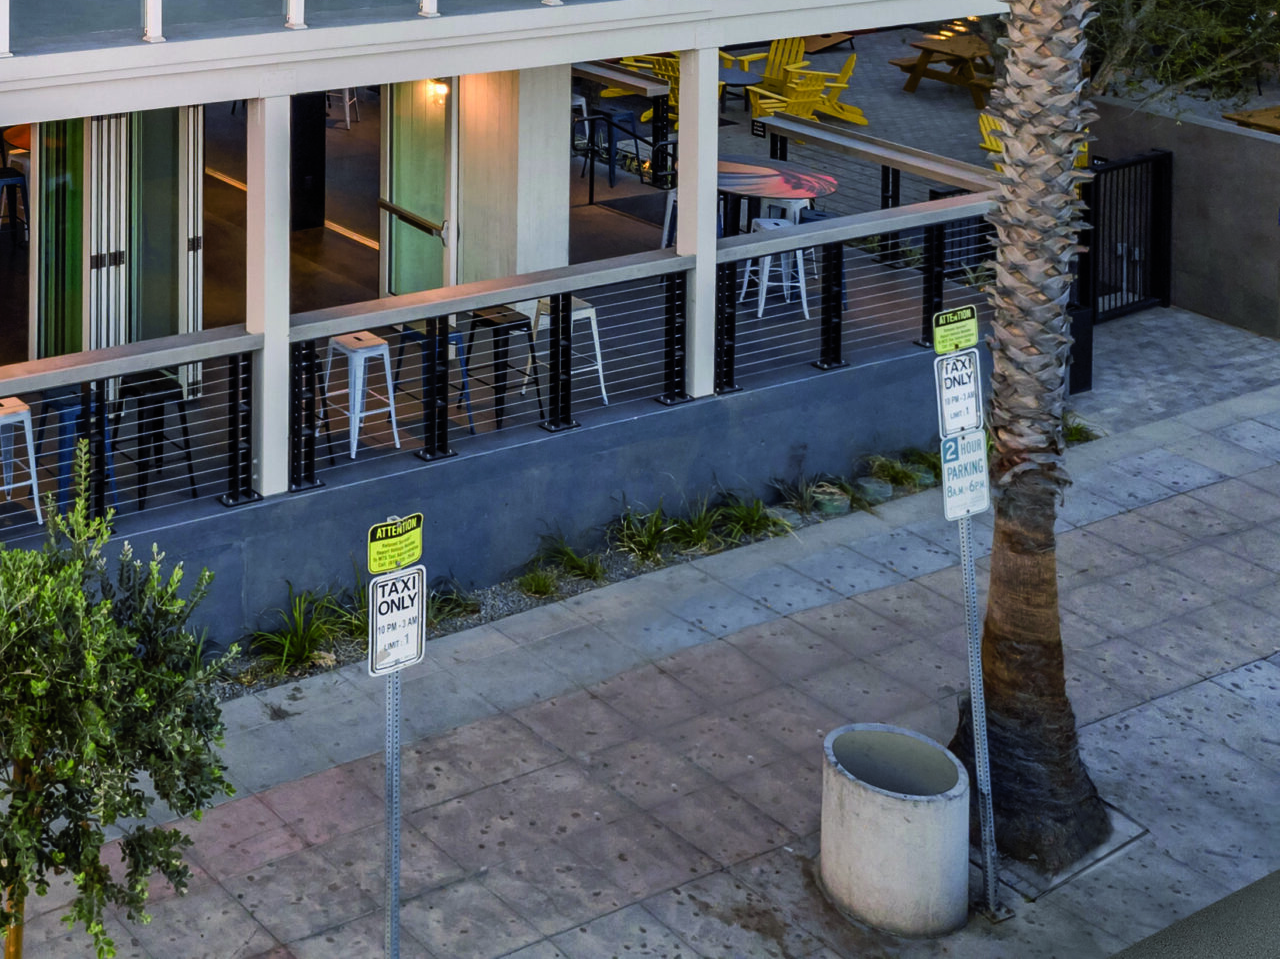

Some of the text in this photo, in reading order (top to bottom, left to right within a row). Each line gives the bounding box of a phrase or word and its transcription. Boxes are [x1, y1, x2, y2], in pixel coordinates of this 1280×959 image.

[939, 309, 971, 325] ATTENTION
[945, 358, 972, 375] TAXI
[944, 371, 973, 389] ONLY
[945, 439, 982, 460] 2 HOUR
[947, 458, 984, 482] PARKING
[376, 517, 417, 539] ATTENTION
[379, 576, 416, 598] TAXI
[378, 592, 417, 616] ONLY
[378, 624, 385, 635] 10
[386, 621, 397, 633] PM
[402, 619, 406, 629] 3
[407, 616, 418, 626] AM
[404, 633, 409, 645] 1
